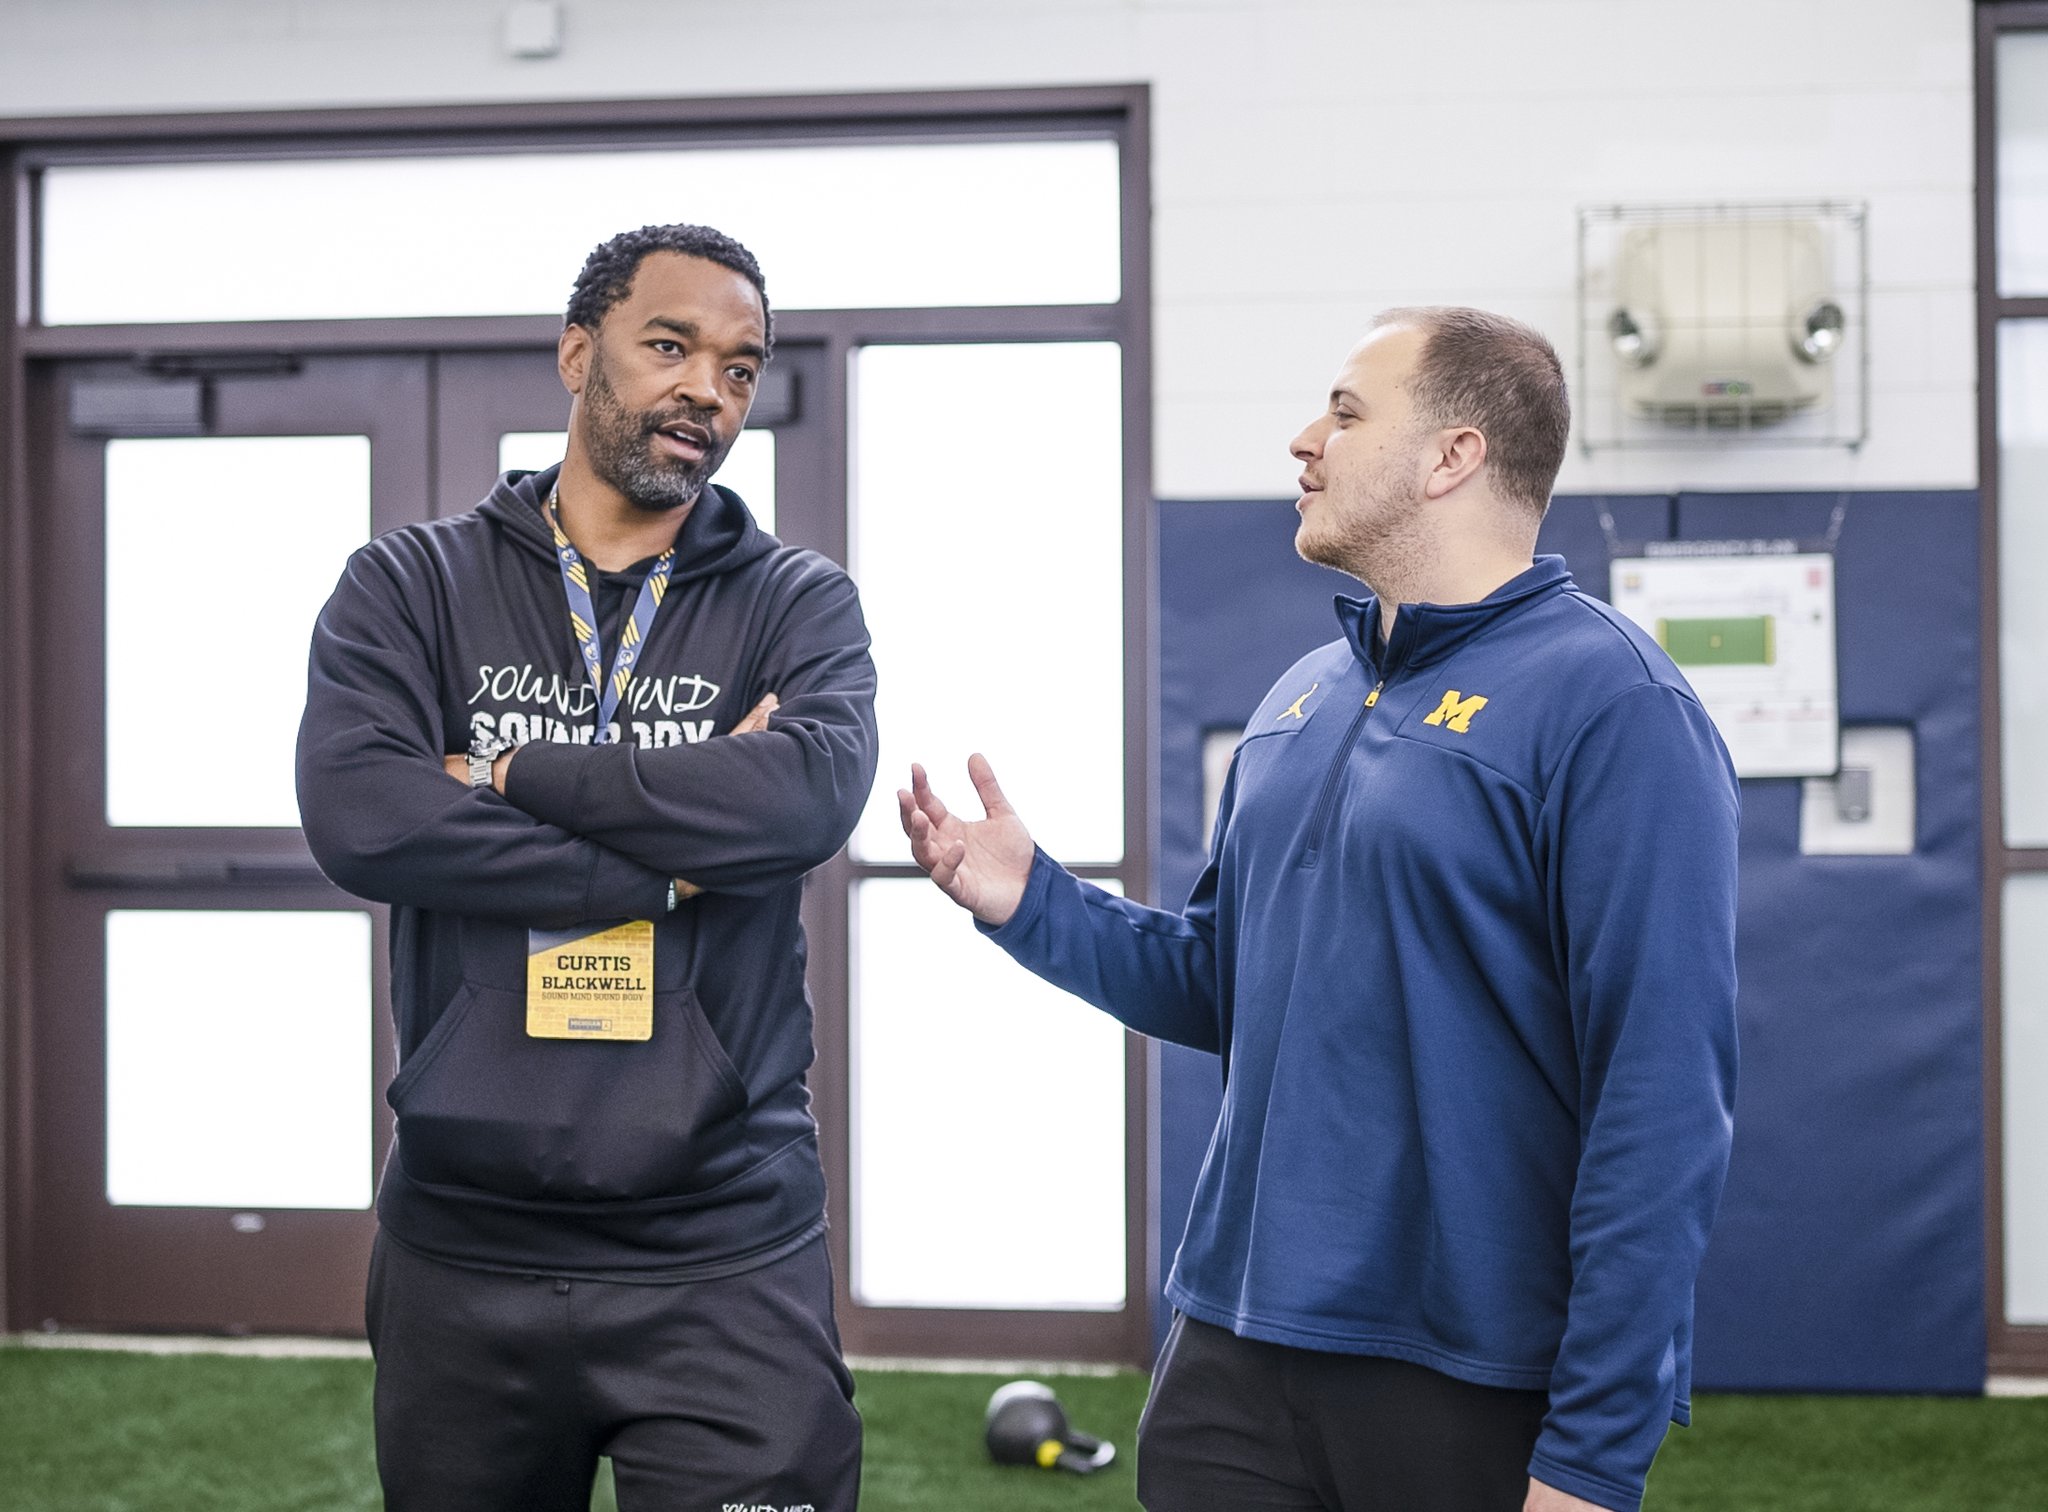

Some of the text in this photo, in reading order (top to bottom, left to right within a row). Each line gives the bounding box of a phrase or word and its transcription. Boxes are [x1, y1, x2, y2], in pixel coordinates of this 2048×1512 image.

[467, 664, 720, 716] SOUND IND
[1423, 690, 1489, 734] M
[557, 955, 631, 971] CURTIS
[541, 976, 646, 990] BLACKWELL
[541, 992, 645, 1002] SOUND MIND SOUND BODY
